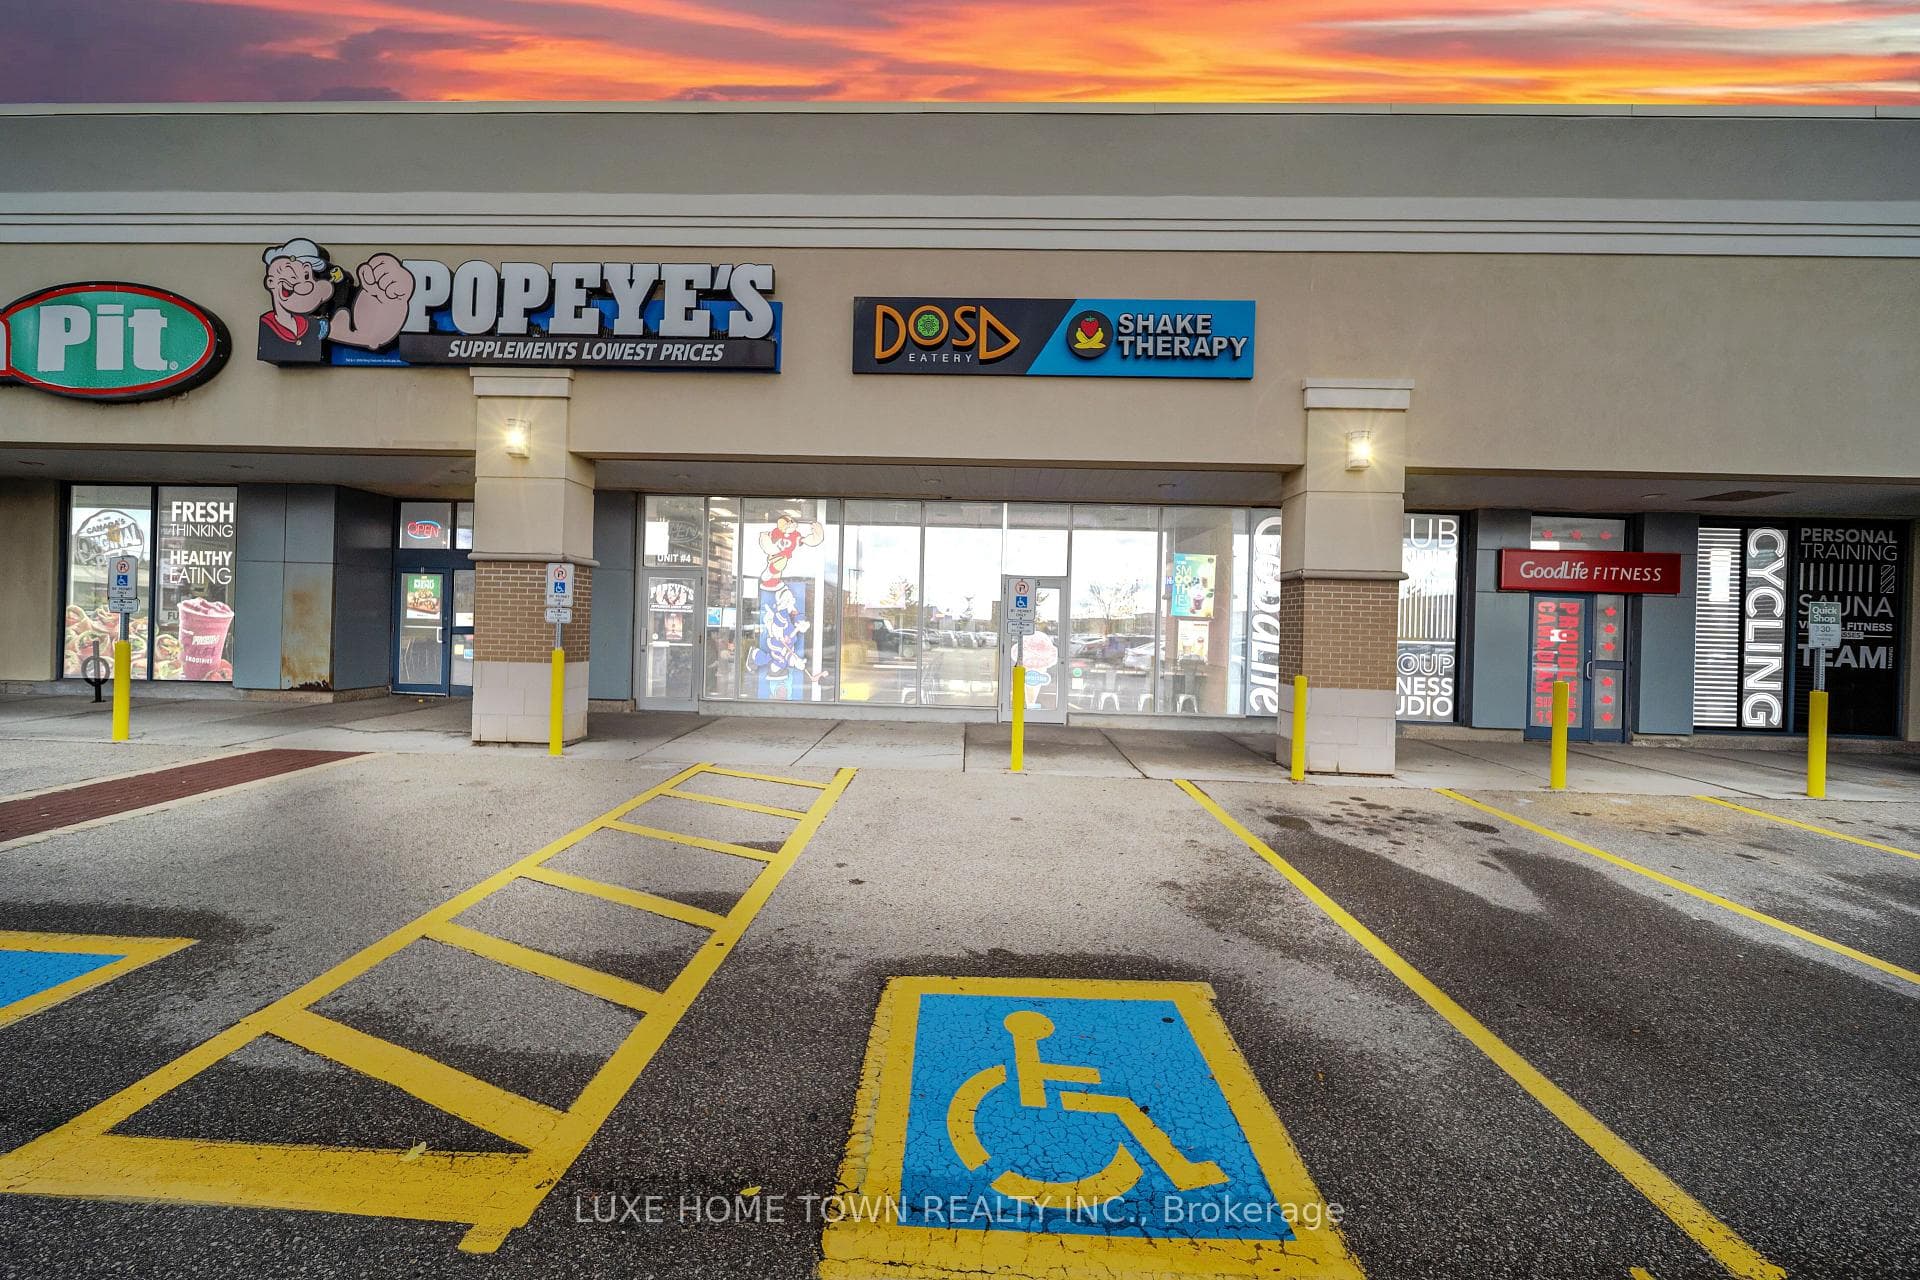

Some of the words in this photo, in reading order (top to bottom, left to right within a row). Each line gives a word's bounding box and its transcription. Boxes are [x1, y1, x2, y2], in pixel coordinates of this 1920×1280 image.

[402, 260, 774, 339] POPEYE'S
[1117, 313, 1213, 335] SHAKE
[37, 304, 168, 372] Pit
[1117, 335, 1248, 358] THERAPY
[448, 340, 578, 361] SUPPLEMENTS
[581, 342, 659, 361] LOWEST
[661, 343, 725, 362] PRICES
[909, 353, 973, 363] EATERY
[171, 501, 234, 523] FRESH
[171, 524, 234, 537] THINKING
[408, 522, 439, 537] OPEN
[1405, 518, 1458, 550] UB
[1800, 528, 1898, 543] PERSONAL
[170, 551, 232, 565] HEALTHY
[657, 554, 679, 562] UNIT
[680, 554, 691, 563] #4
[1801, 543, 1898, 561] TRAINING
[170, 567, 232, 584] EATING
[1520, 561, 1589, 580] GoodLife
[1593, 567, 1662, 582] FITNESS
[1812, 606, 1838, 616] Quick
[1813, 614, 1836, 624] Shop
[1742, 527, 1785, 727] CYCLING
[1847, 622, 1893, 632] FITNESS
[1397, 653, 1454, 677] OUP
[1797, 643, 1887, 669] TEAM
[1396, 676, 1453, 696] NESS
